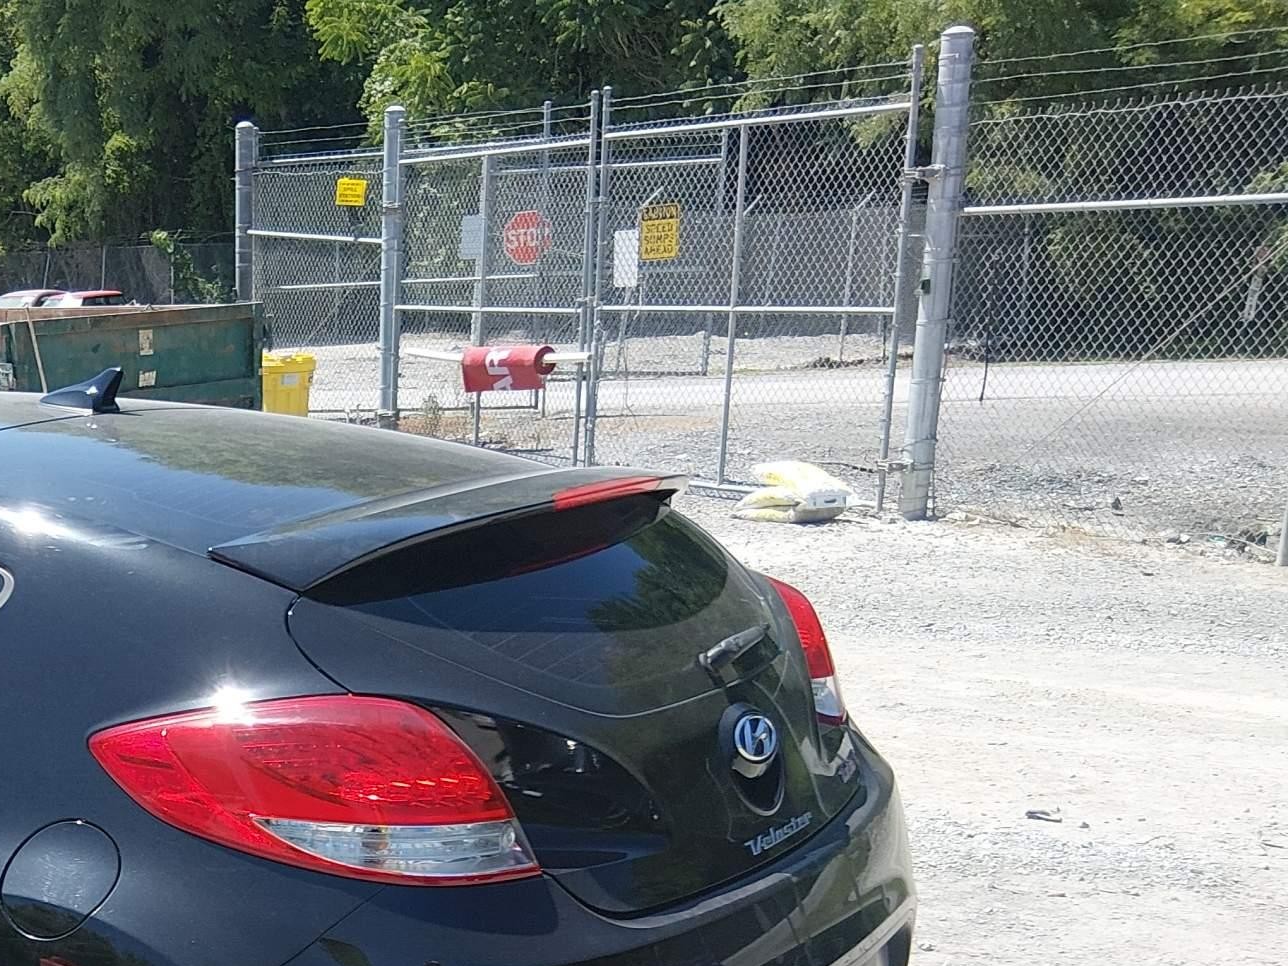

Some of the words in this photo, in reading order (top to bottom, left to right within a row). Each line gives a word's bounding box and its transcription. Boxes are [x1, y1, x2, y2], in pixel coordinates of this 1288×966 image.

[645, 222, 674, 233] SPEED
[643, 244, 674, 255] AHEAD
[743, 811, 813, 856] Veloster
